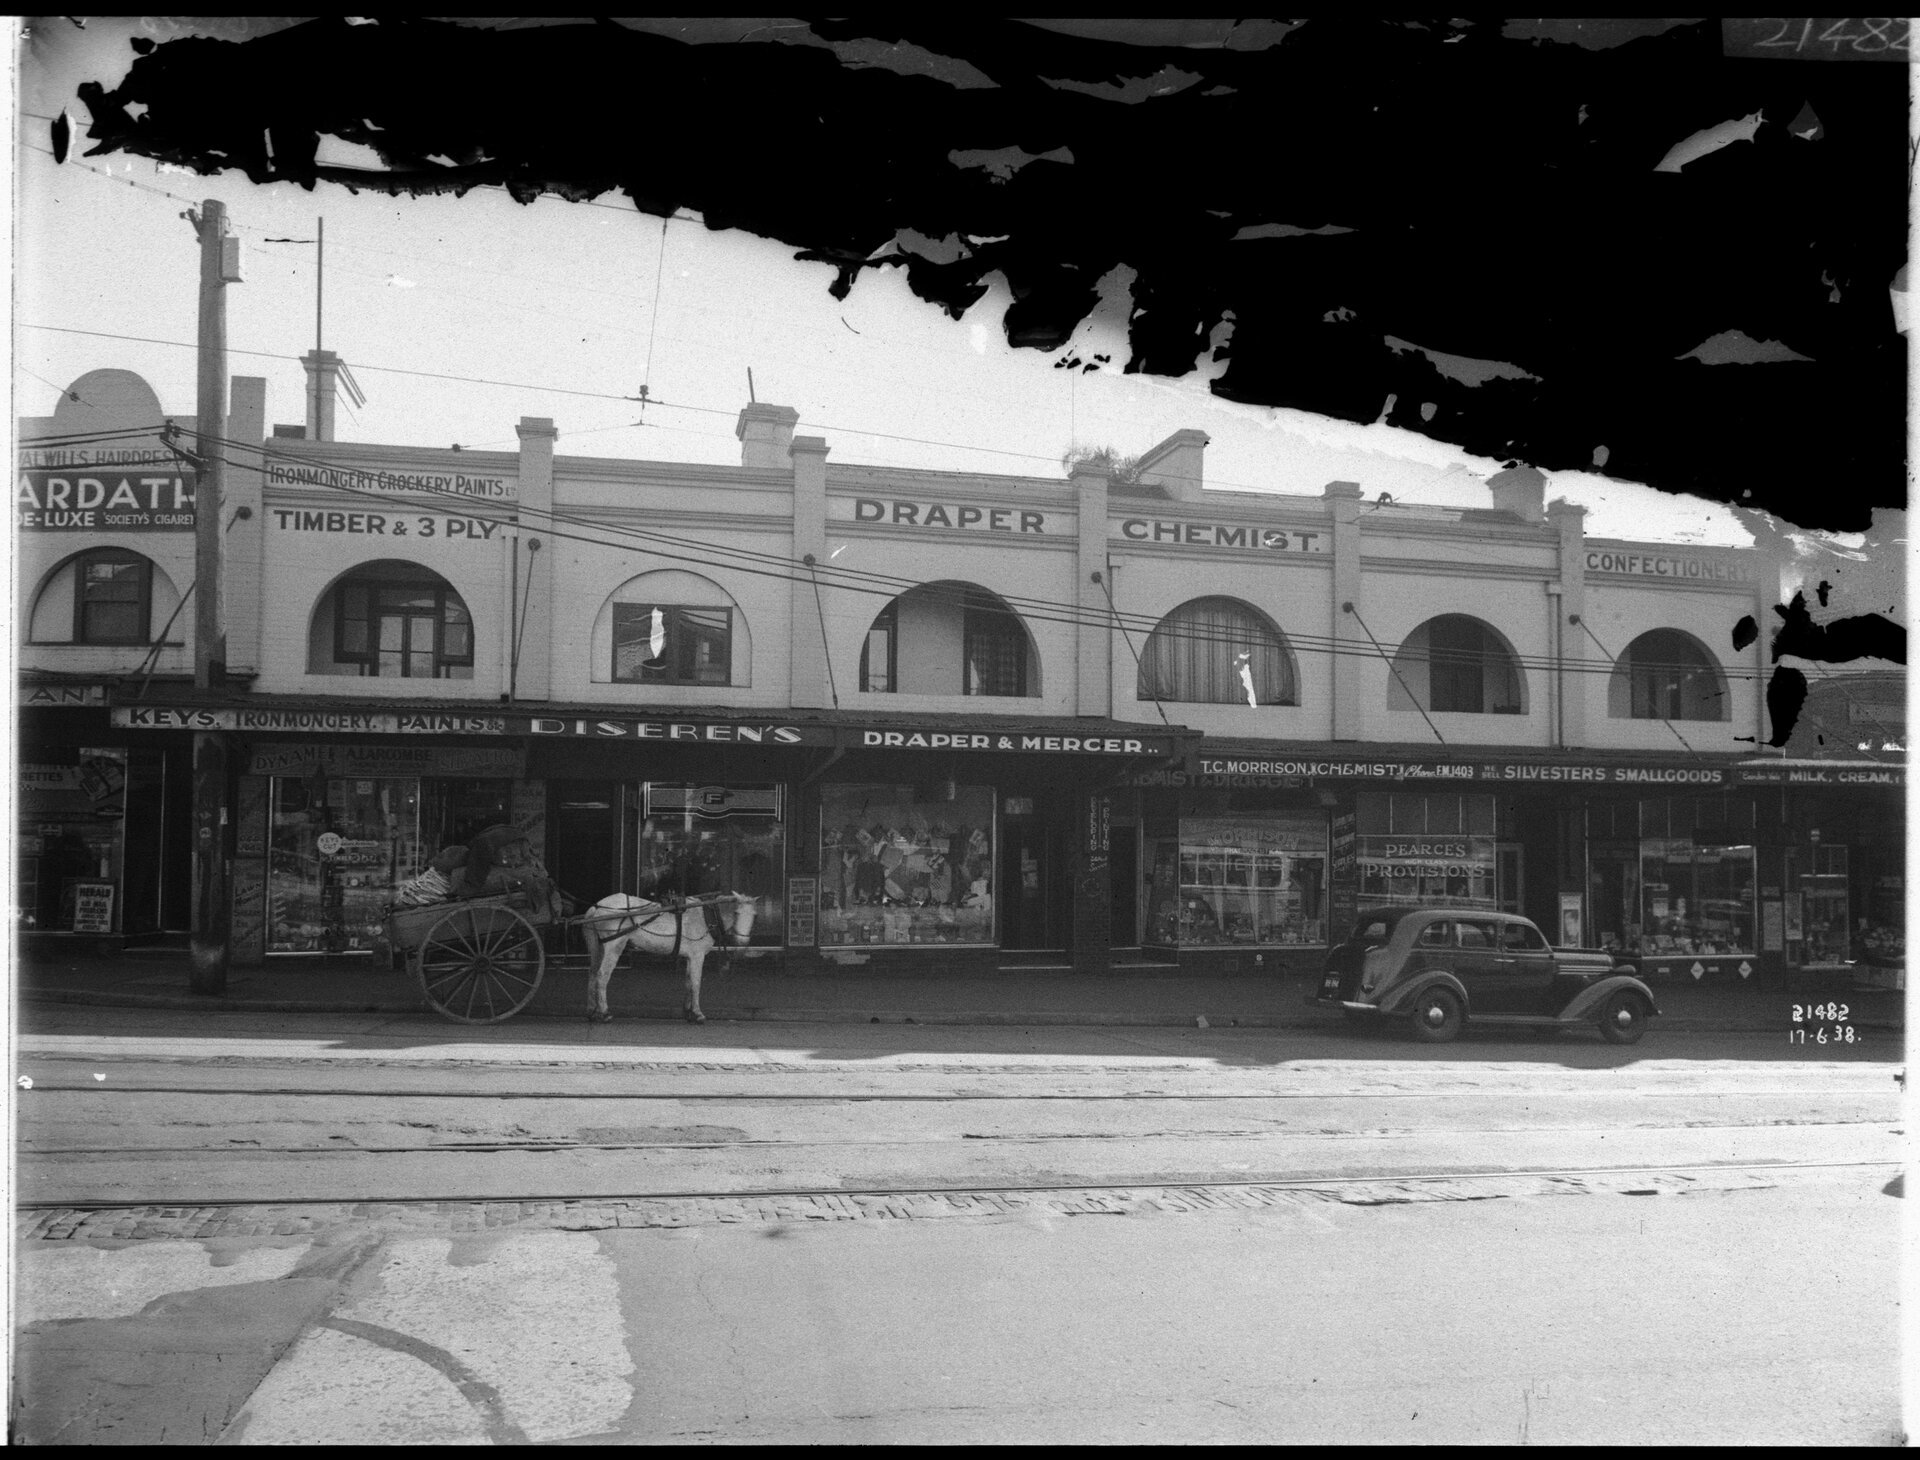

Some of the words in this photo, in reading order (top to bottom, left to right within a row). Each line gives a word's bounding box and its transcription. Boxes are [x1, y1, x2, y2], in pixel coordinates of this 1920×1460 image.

[17, 474, 197, 510] ARDATH
[270, 465, 373, 489] IRONMONGERY
[378, 471, 452, 492] CROCKERY
[456, 475, 504, 497] PAINTS
[273, 509, 387, 535] TIMBER
[392, 521, 408, 536] &
[418, 517, 436, 537] 3
[446, 518, 499, 540] PLY
[854, 499, 1045, 534] DRAPER
[1586, 553, 1751, 582] CONFECTIONERY
[398, 715, 485, 731] PAINTS
[531, 718, 803, 743] DISEREN'S
[864, 731, 990, 749] DRAPER
[997, 735, 1015, 750] &
[1317, 763, 1397, 776] CHEMIST
[1615, 768, 1722, 783] SMALLGOODS
[1366, 863, 1485, 878] PROVISIONS
